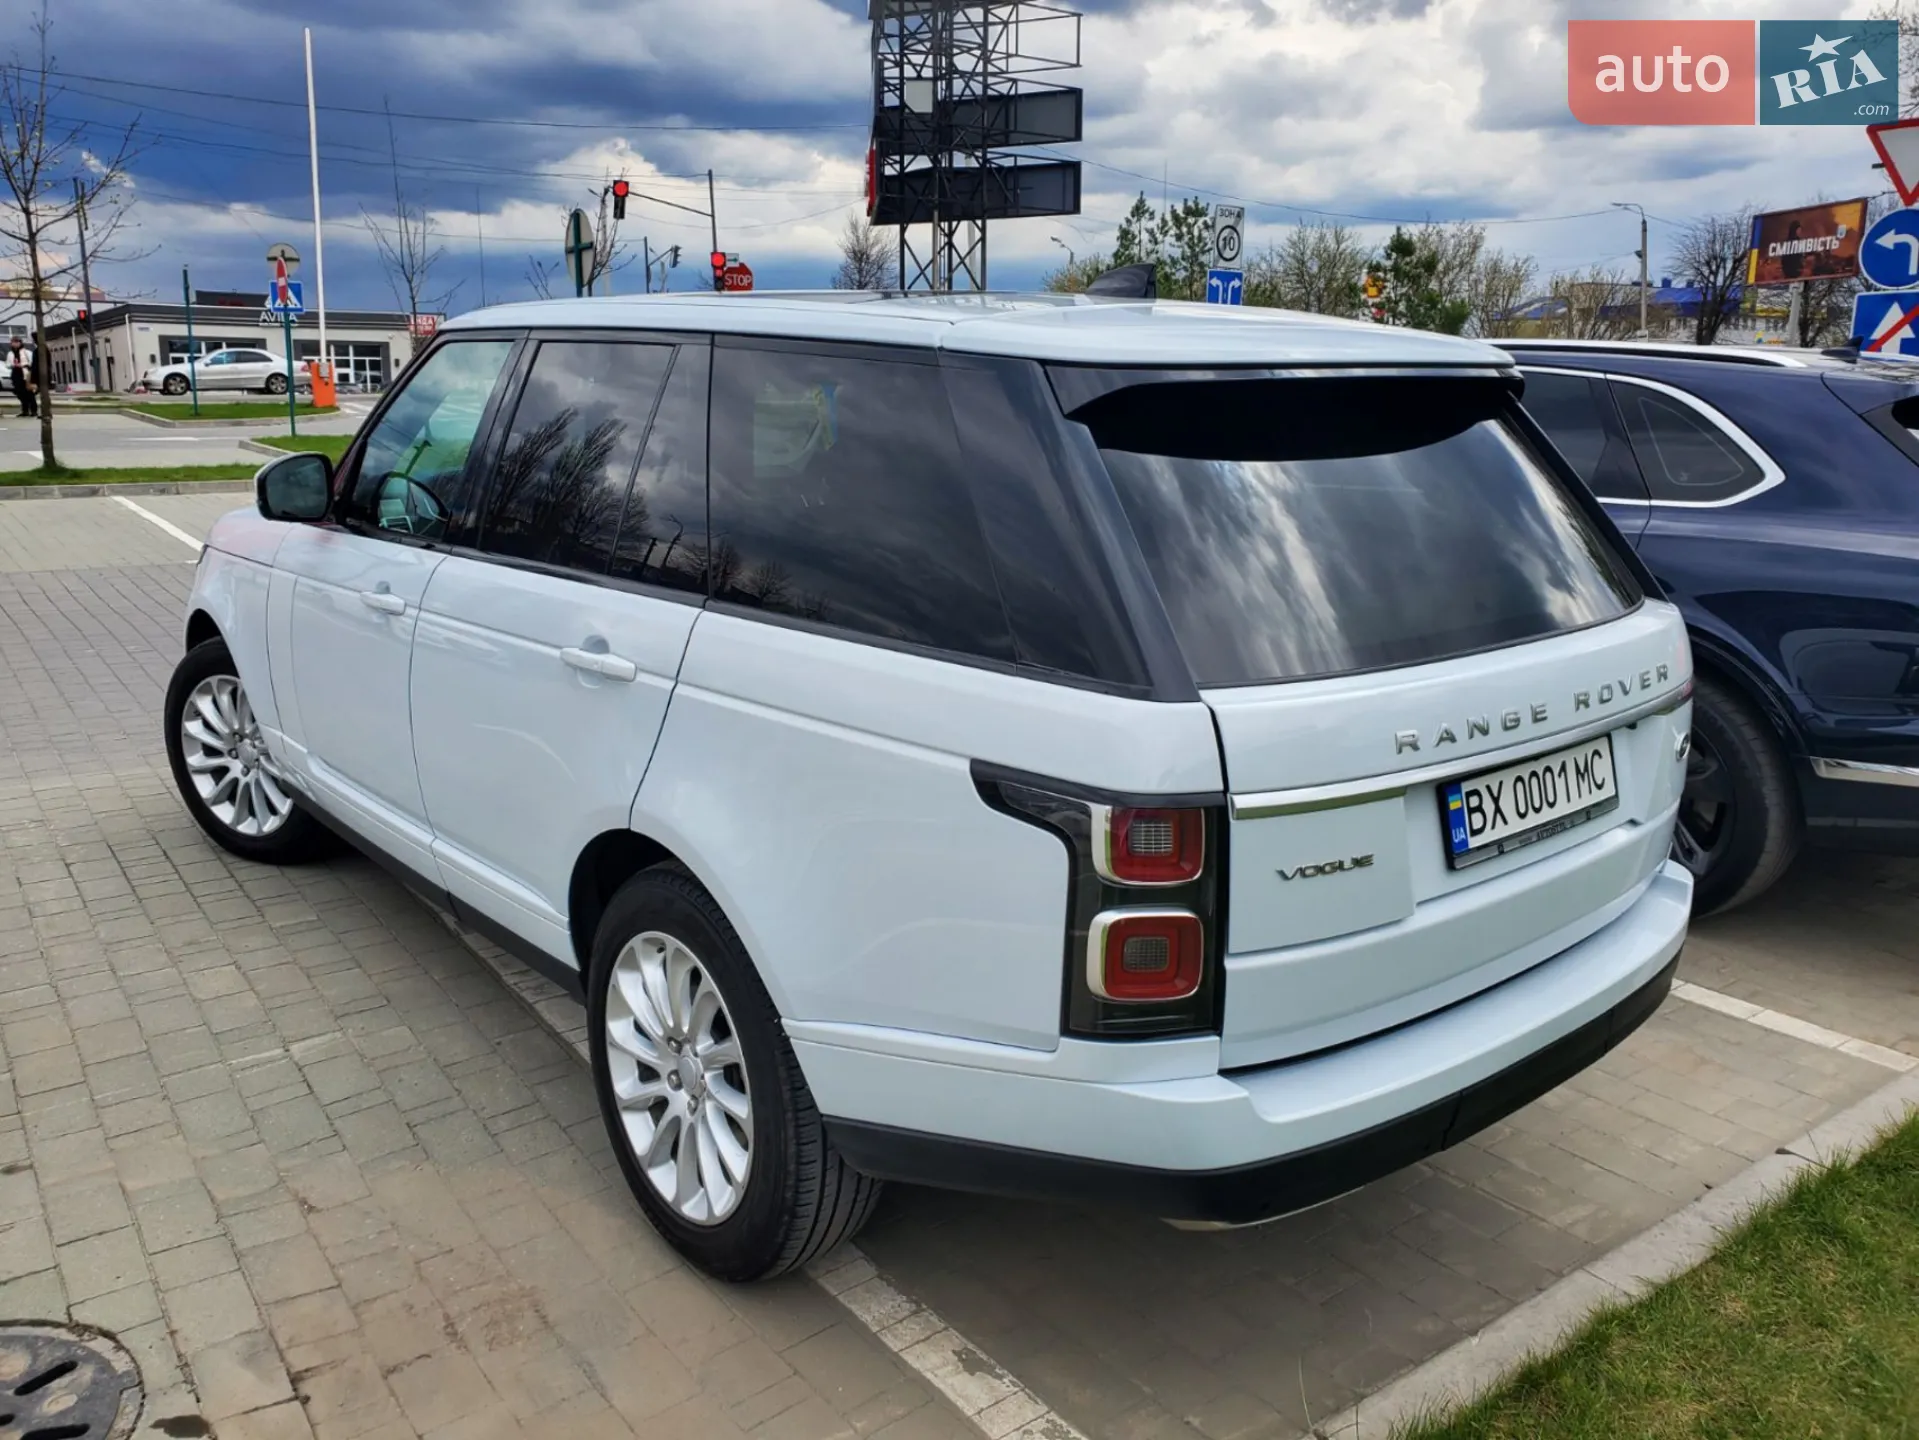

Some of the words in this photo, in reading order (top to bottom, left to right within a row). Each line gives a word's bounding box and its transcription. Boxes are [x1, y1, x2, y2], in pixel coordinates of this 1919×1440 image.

[1222, 235, 1235, 252] 10
[1768, 236, 1840, 257] СМІЛИВІСТЬ
[724, 273, 752, 287] STOP
[1395, 702, 1549, 755] RANGE
[1573, 663, 1670, 712] ROVER
[1464, 780, 1509, 838] BX
[1512, 759, 1572, 820] 0001
[1573, 748, 1606, 799] MC
[1452, 827, 1466, 843] UA
[1275, 854, 1375, 882] VOGUE
